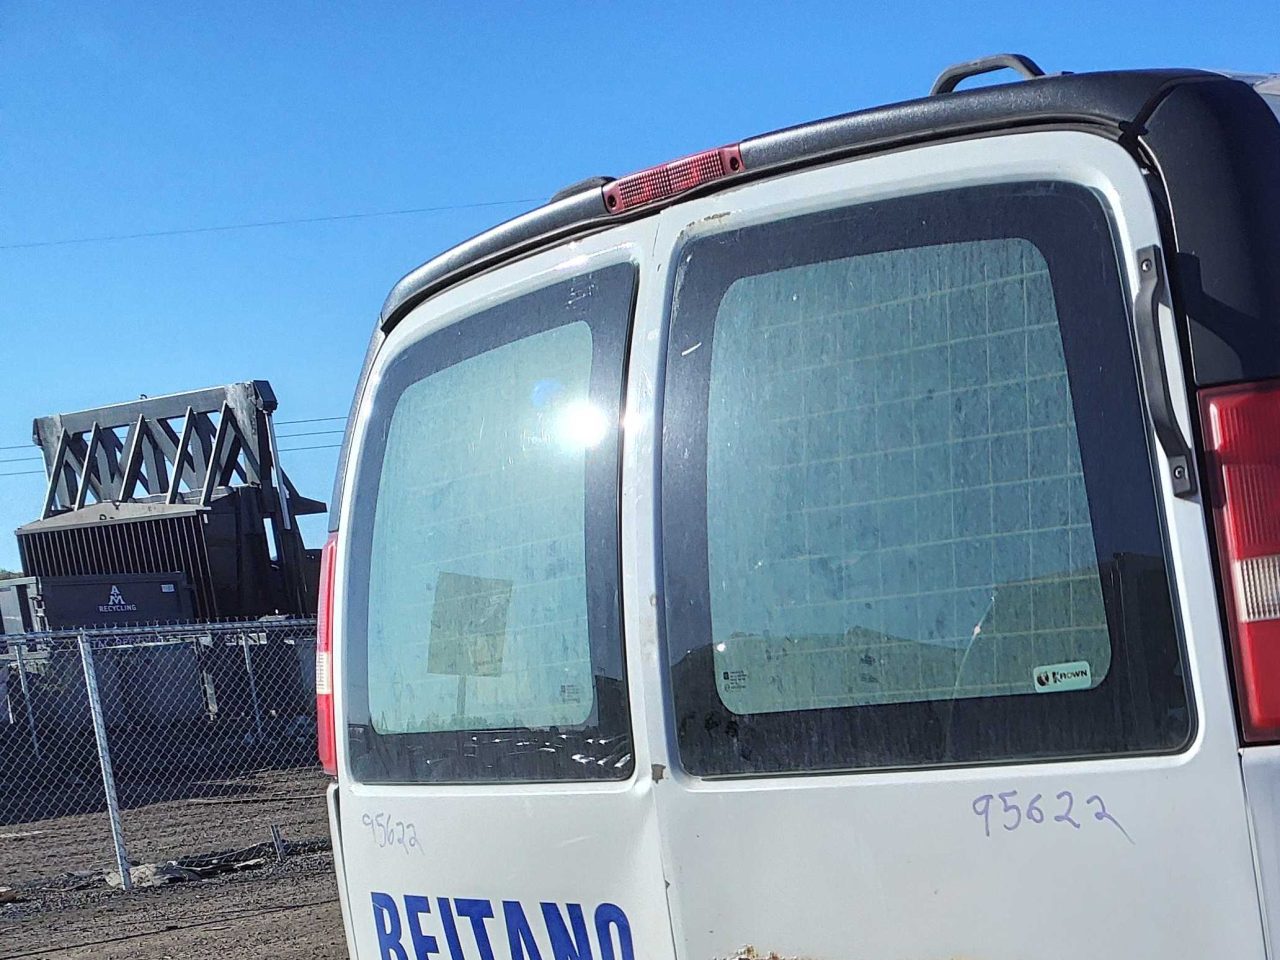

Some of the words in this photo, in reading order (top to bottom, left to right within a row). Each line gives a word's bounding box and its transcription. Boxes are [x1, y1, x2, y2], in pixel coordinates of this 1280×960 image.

[98, 604, 137, 613] RECYCLING
[362, 812, 424, 856] 95622
[972, 790, 1135, 844] 95622
